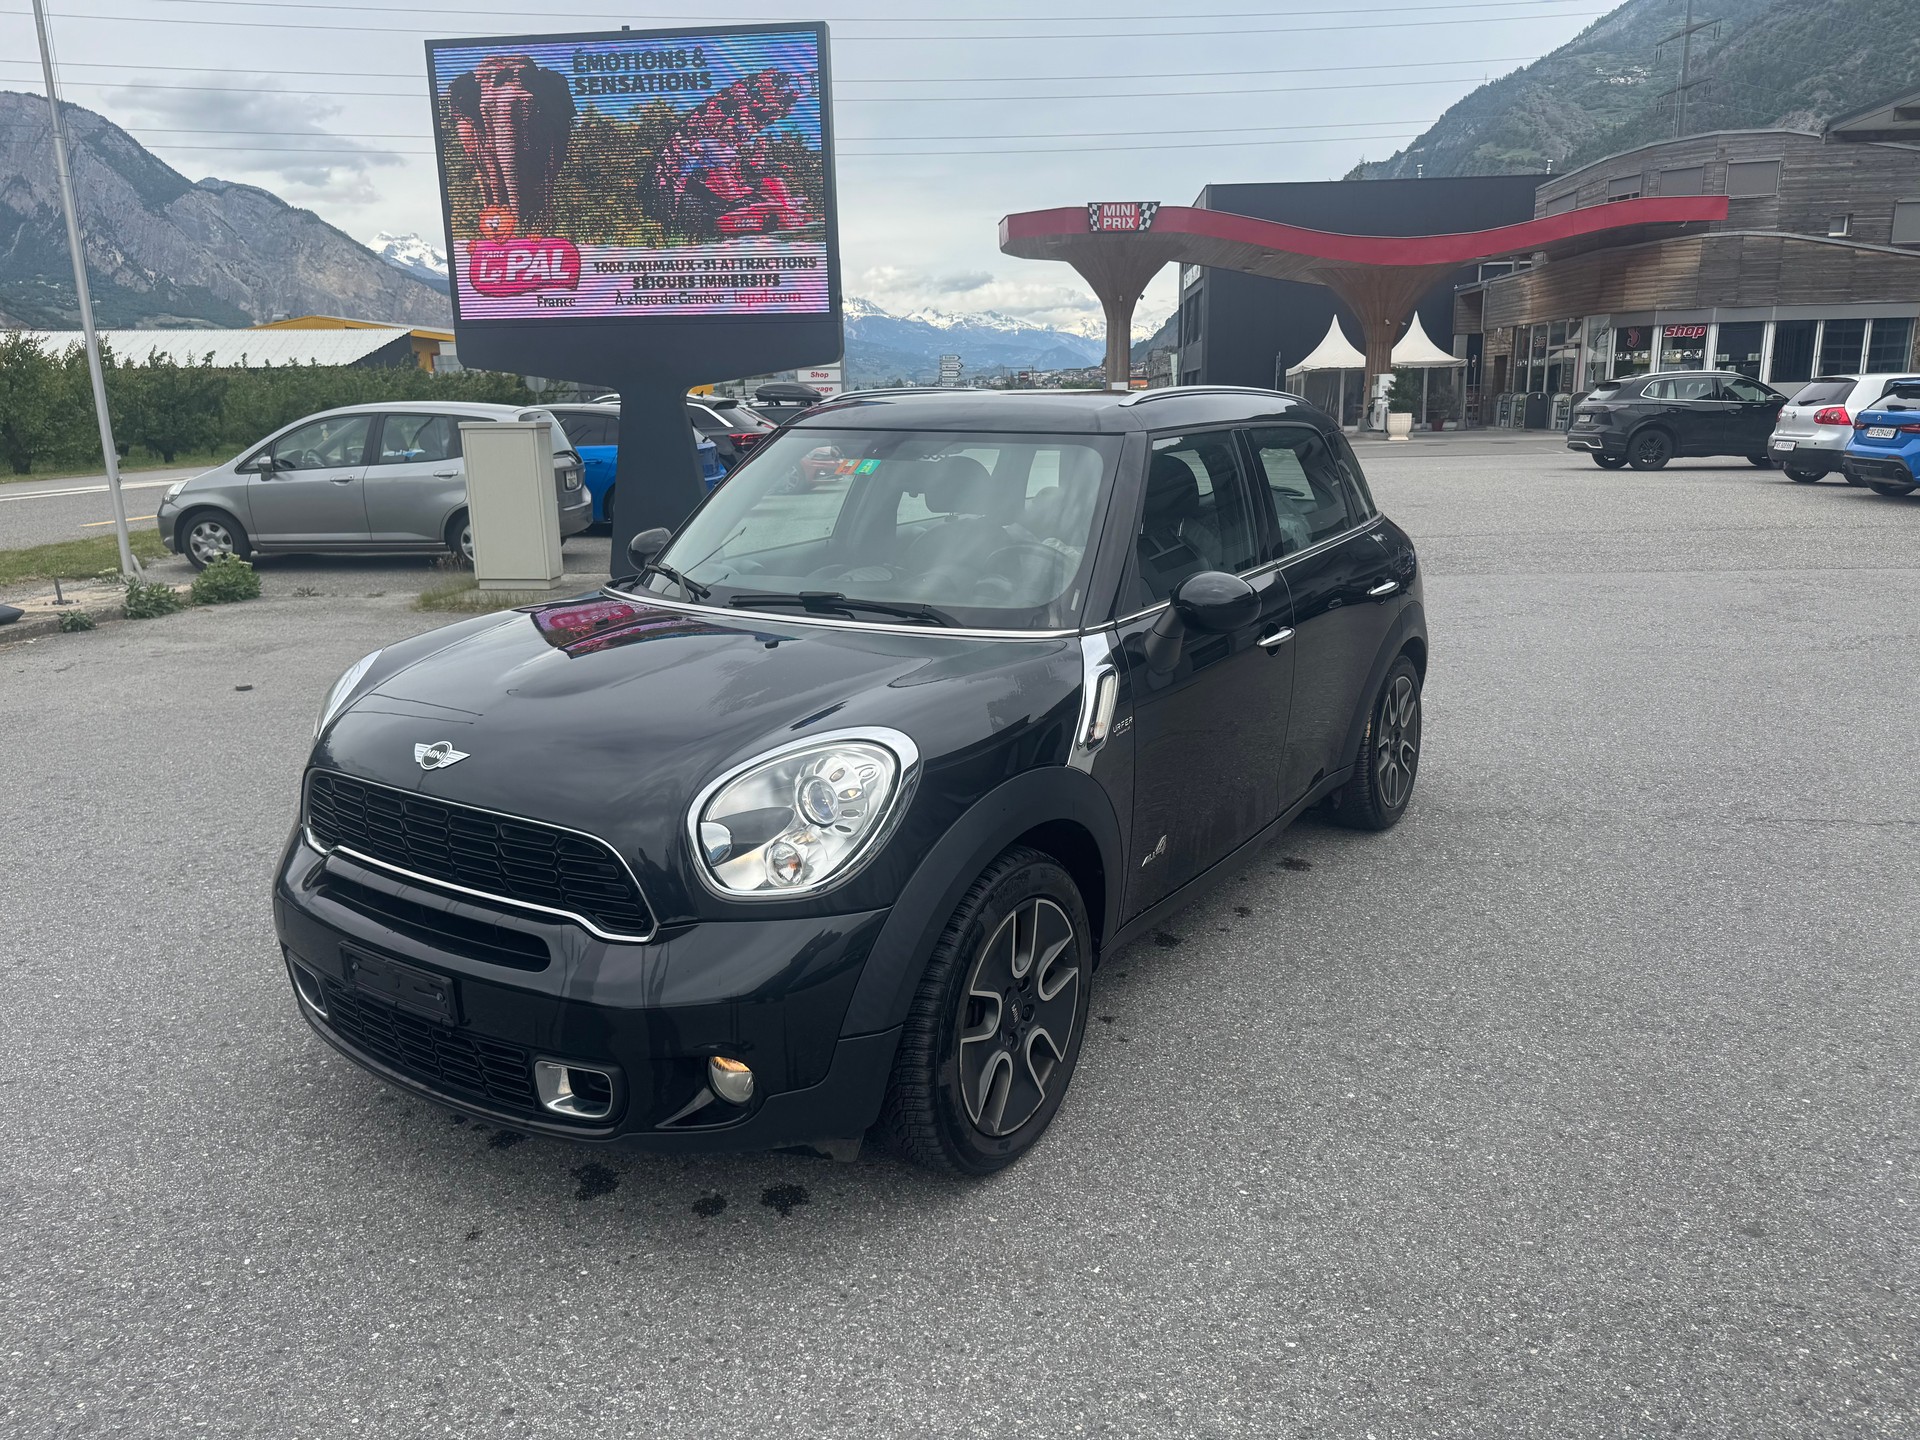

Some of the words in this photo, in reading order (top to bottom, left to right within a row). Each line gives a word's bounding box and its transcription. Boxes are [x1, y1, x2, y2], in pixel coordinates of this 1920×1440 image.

[573, 47, 687, 72] ÉMOTIONS
[693, 46, 708, 68] &
[574, 72, 713, 95] SENSATIONS
[1103, 204, 1135, 217] MINI
[1103, 217, 1135, 229] PRIX
[506, 249, 570, 281] PAL
[594, 261, 623, 273] 1000
[627, 259, 694, 273] ANIMAUX
[721, 257, 817, 270] ATTRACTIONS
[633, 273, 694, 289] SÉJOURS
[700, 273, 781, 288] IMMERSIFS
[536, 294, 577, 308] France
[679, 291, 725, 304] Genève
[734, 289, 801, 307] lepal.com
[1663, 324, 1706, 339] Shop
[810, 371, 829, 379] Shop
[426, 749, 446, 760] MINI
